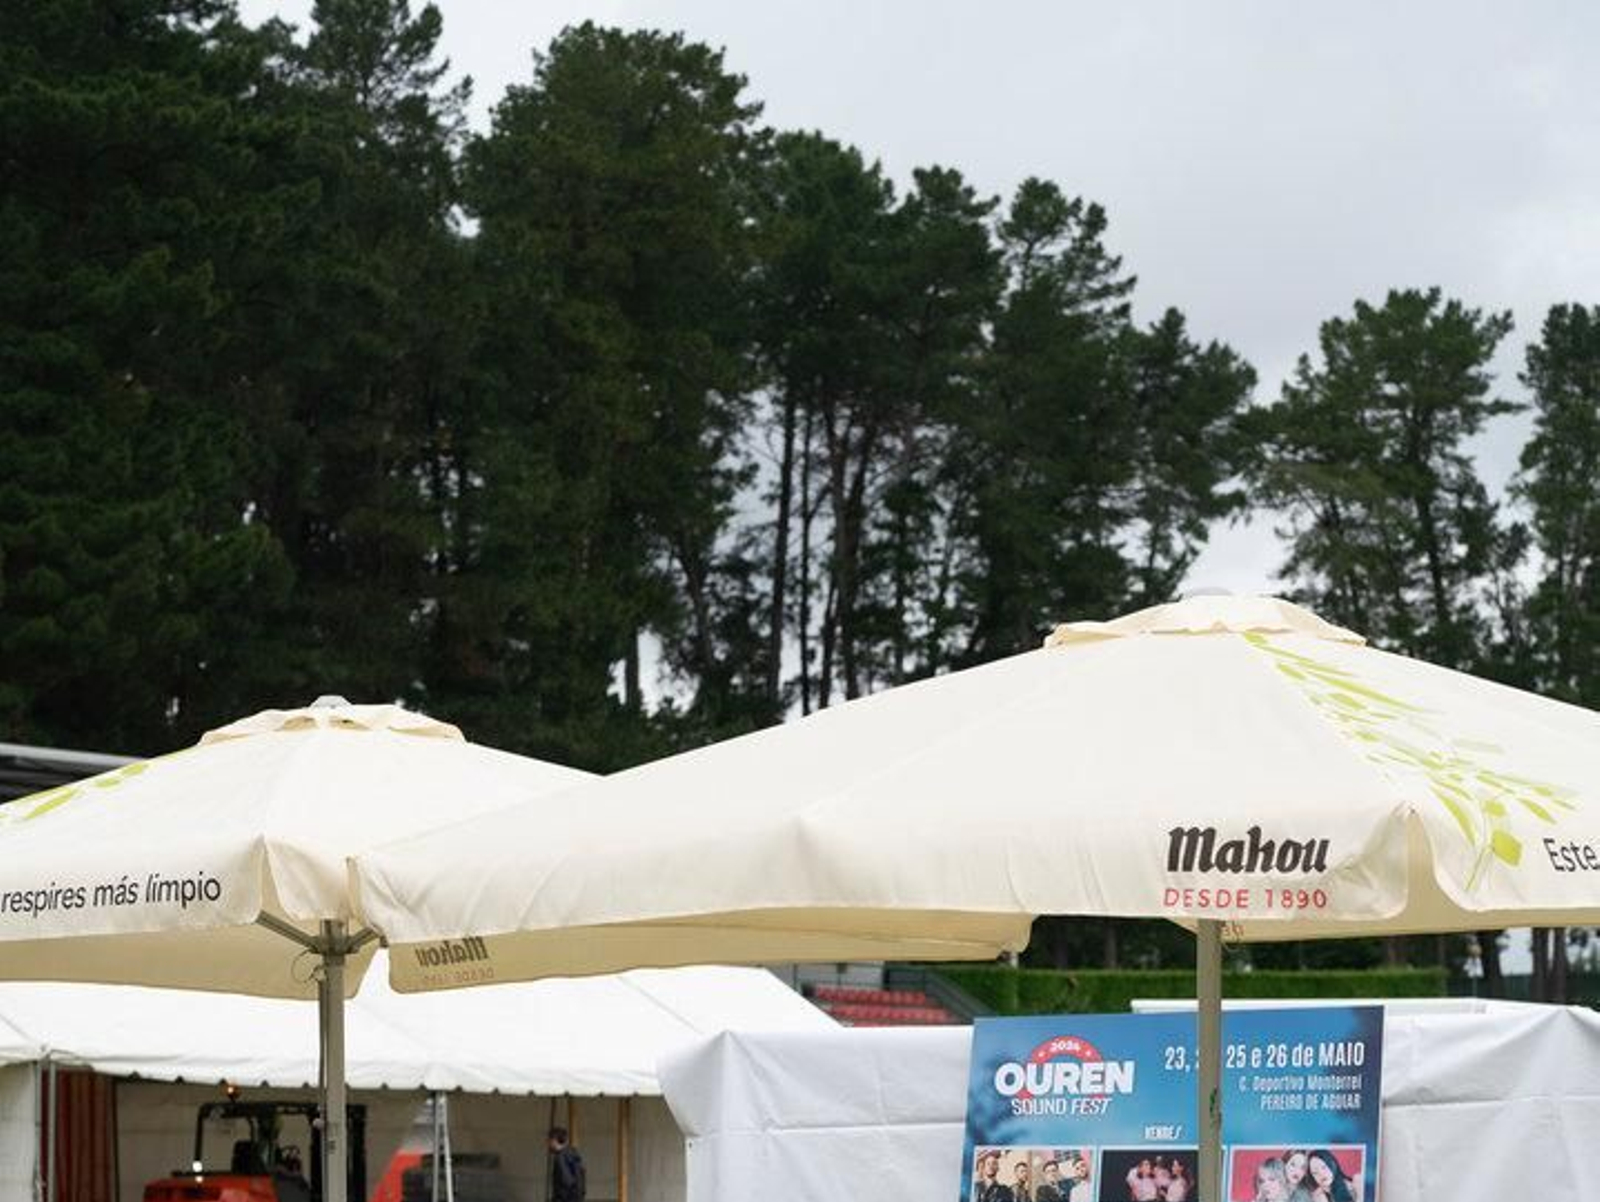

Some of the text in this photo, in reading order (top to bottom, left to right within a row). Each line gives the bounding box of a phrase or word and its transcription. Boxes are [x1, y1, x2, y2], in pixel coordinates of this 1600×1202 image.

[1167, 827, 1329, 874] Mahou
[1543, 837, 1600, 873] Este
[1, 882, 86, 918] respires
[93, 875, 139, 907] más
[1163, 887, 1328, 909] DESDE 1890
[1164, 1046, 1190, 1072] 23,
[1226, 1044, 1247, 1068] 25
[1251, 1047, 1262, 1067] e
[1266, 1043, 1287, 1068] 26
[1291, 1042, 1314, 1068] de
[1318, 1042, 1365, 1067] MAIO
[994, 1060, 1135, 1096] OUREN
[1011, 1097, 1112, 1115] SOUND FEST
[1305, 1094, 1318, 1110] DE
